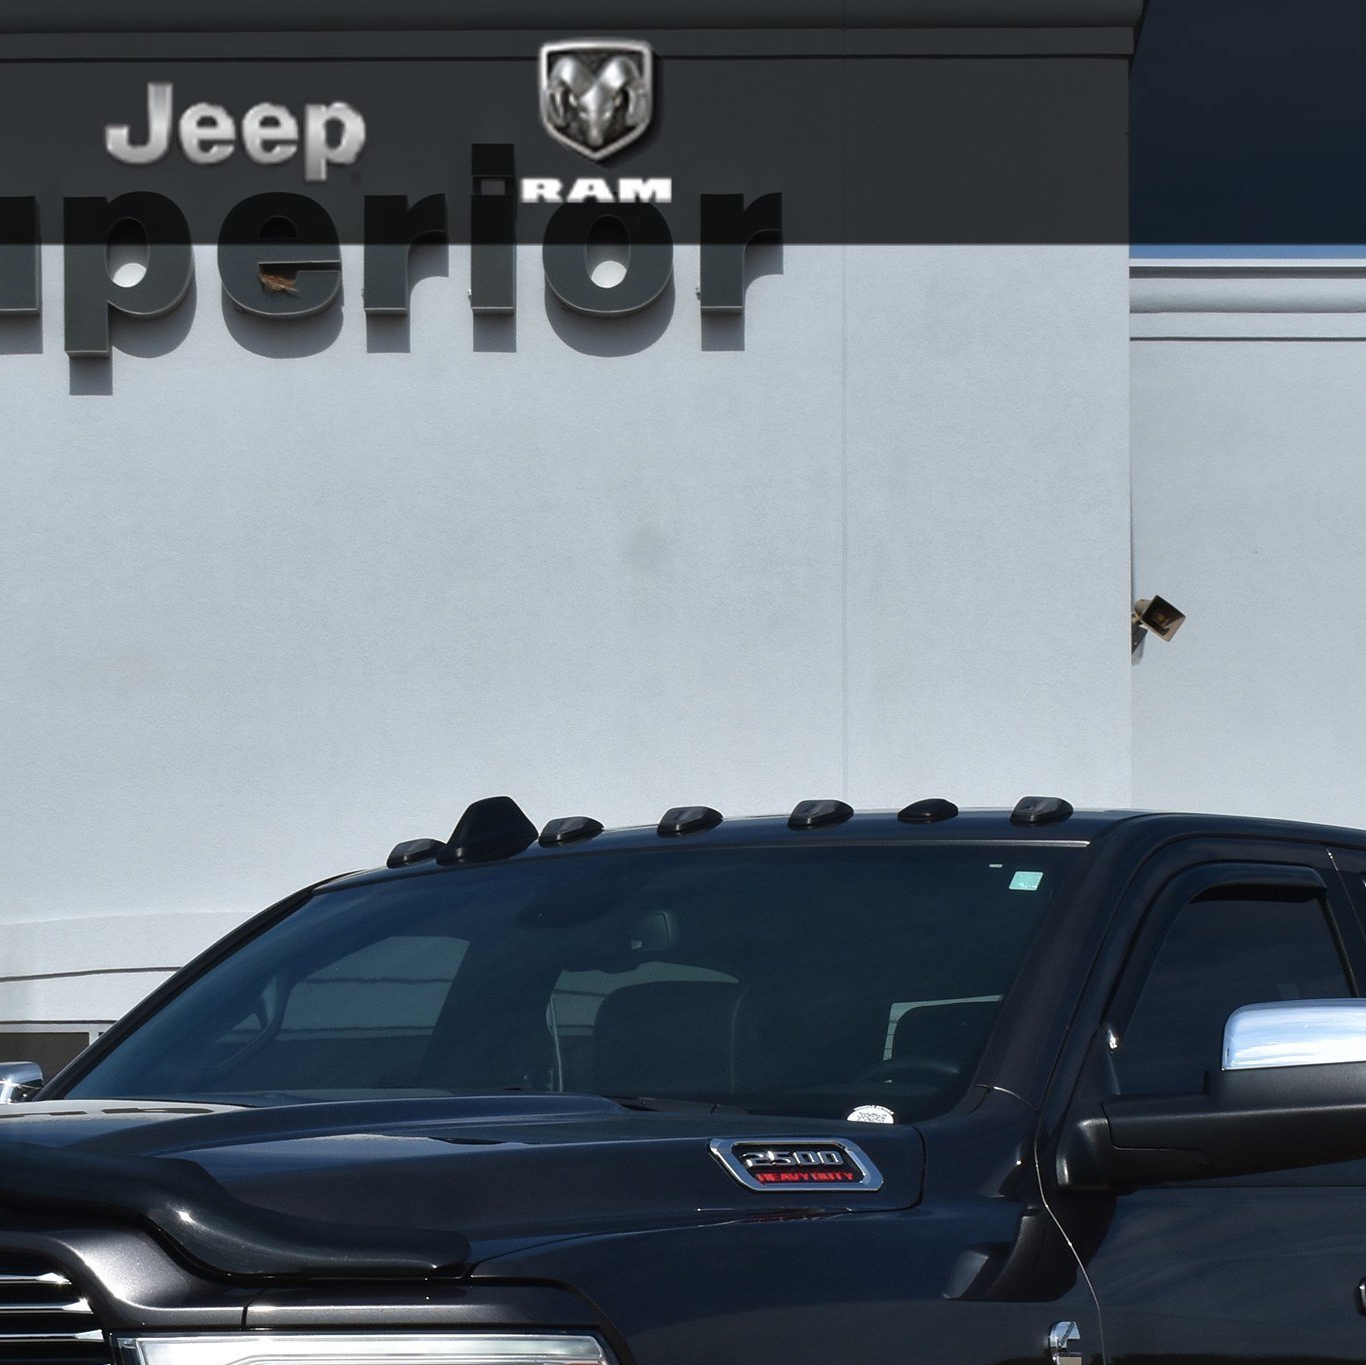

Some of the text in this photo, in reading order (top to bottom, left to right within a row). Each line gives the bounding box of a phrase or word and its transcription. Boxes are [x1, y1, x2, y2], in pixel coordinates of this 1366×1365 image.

[741, 1150, 844, 1167] 2500
[756, 1171, 855, 1183] HEAVY DUTY
